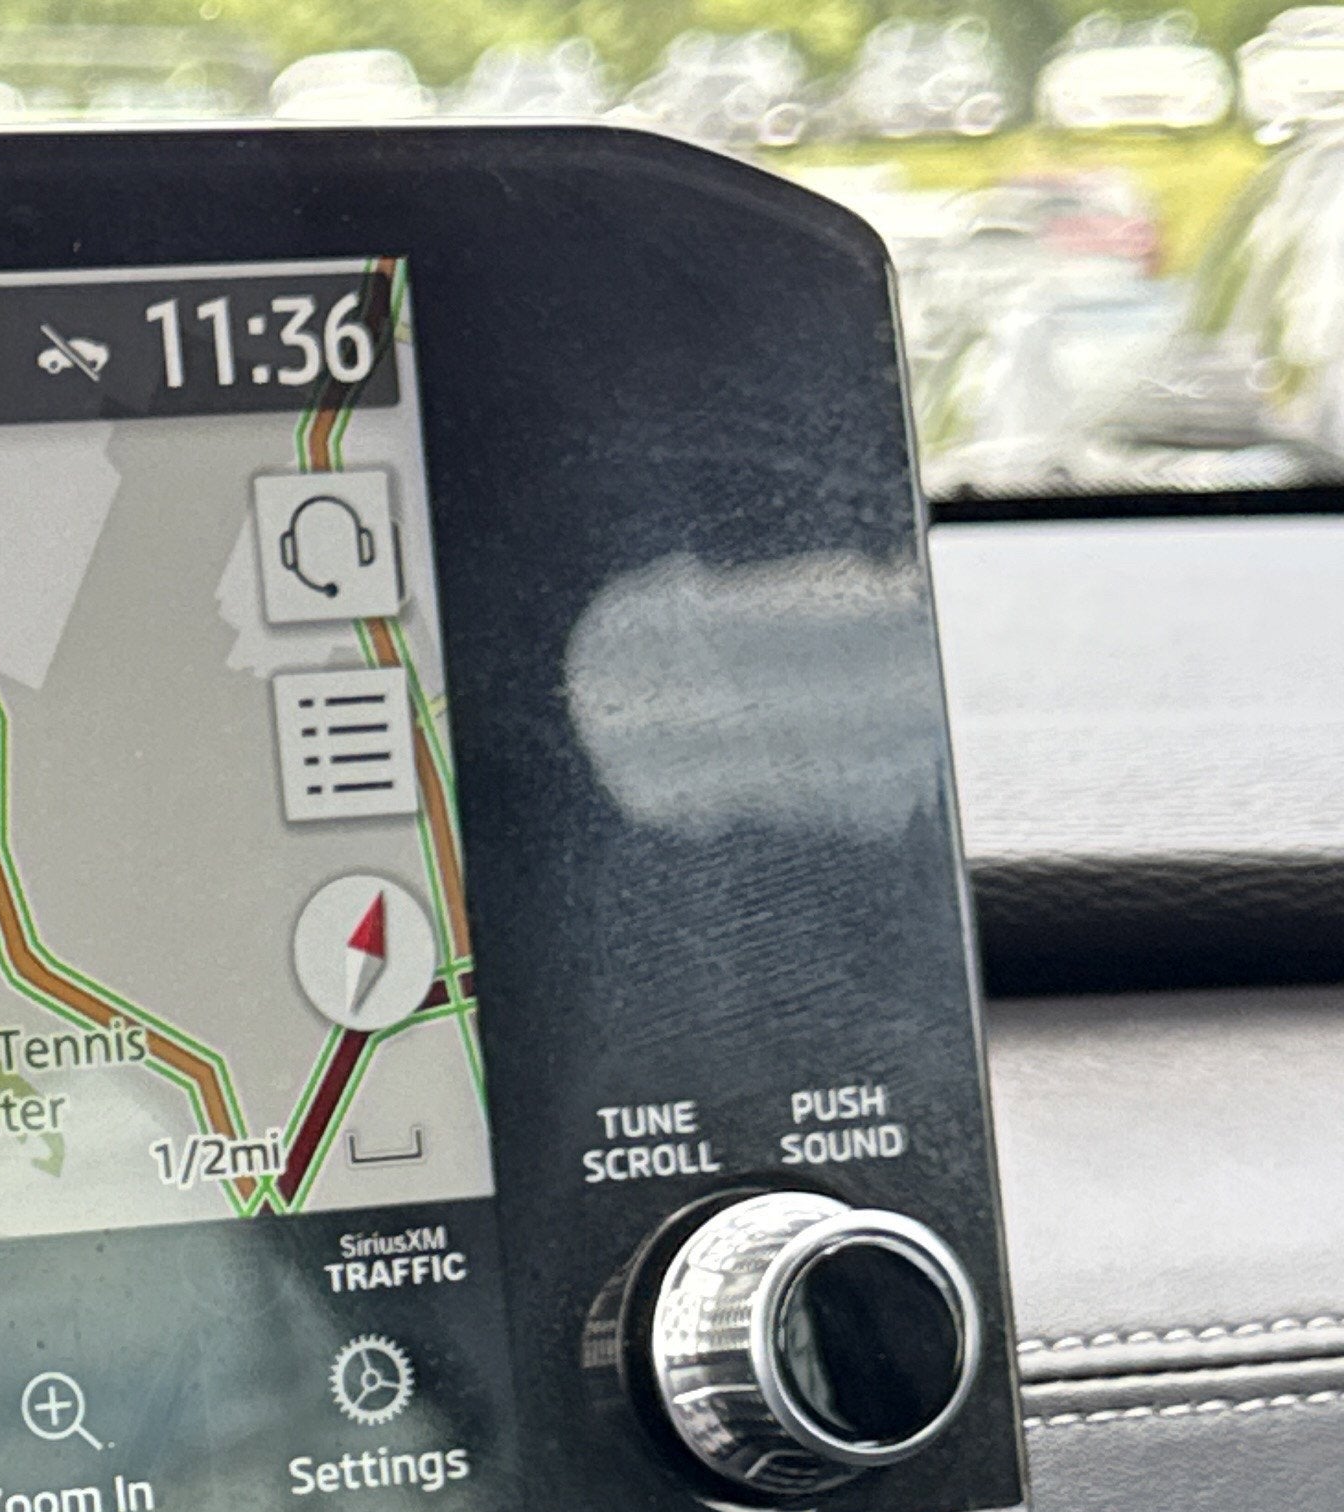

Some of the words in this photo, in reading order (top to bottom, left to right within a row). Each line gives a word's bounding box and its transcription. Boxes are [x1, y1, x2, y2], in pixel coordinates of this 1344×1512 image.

[145, 294, 375, 388] 11:36
[596, 1101, 699, 1139] TUNE
[791, 1085, 888, 1125] PUSH
[152, 1131, 283, 1184] 1/2mi
[582, 1140, 721, 1184] SCROLL
[780, 1125, 904, 1165] SOUND
[339, 1226, 448, 1258] SiriusXM
[324, 1253, 468, 1293] TRAFFIC
[288, 1446, 470, 1495] Settings
[114, 1474, 155, 1512] In
